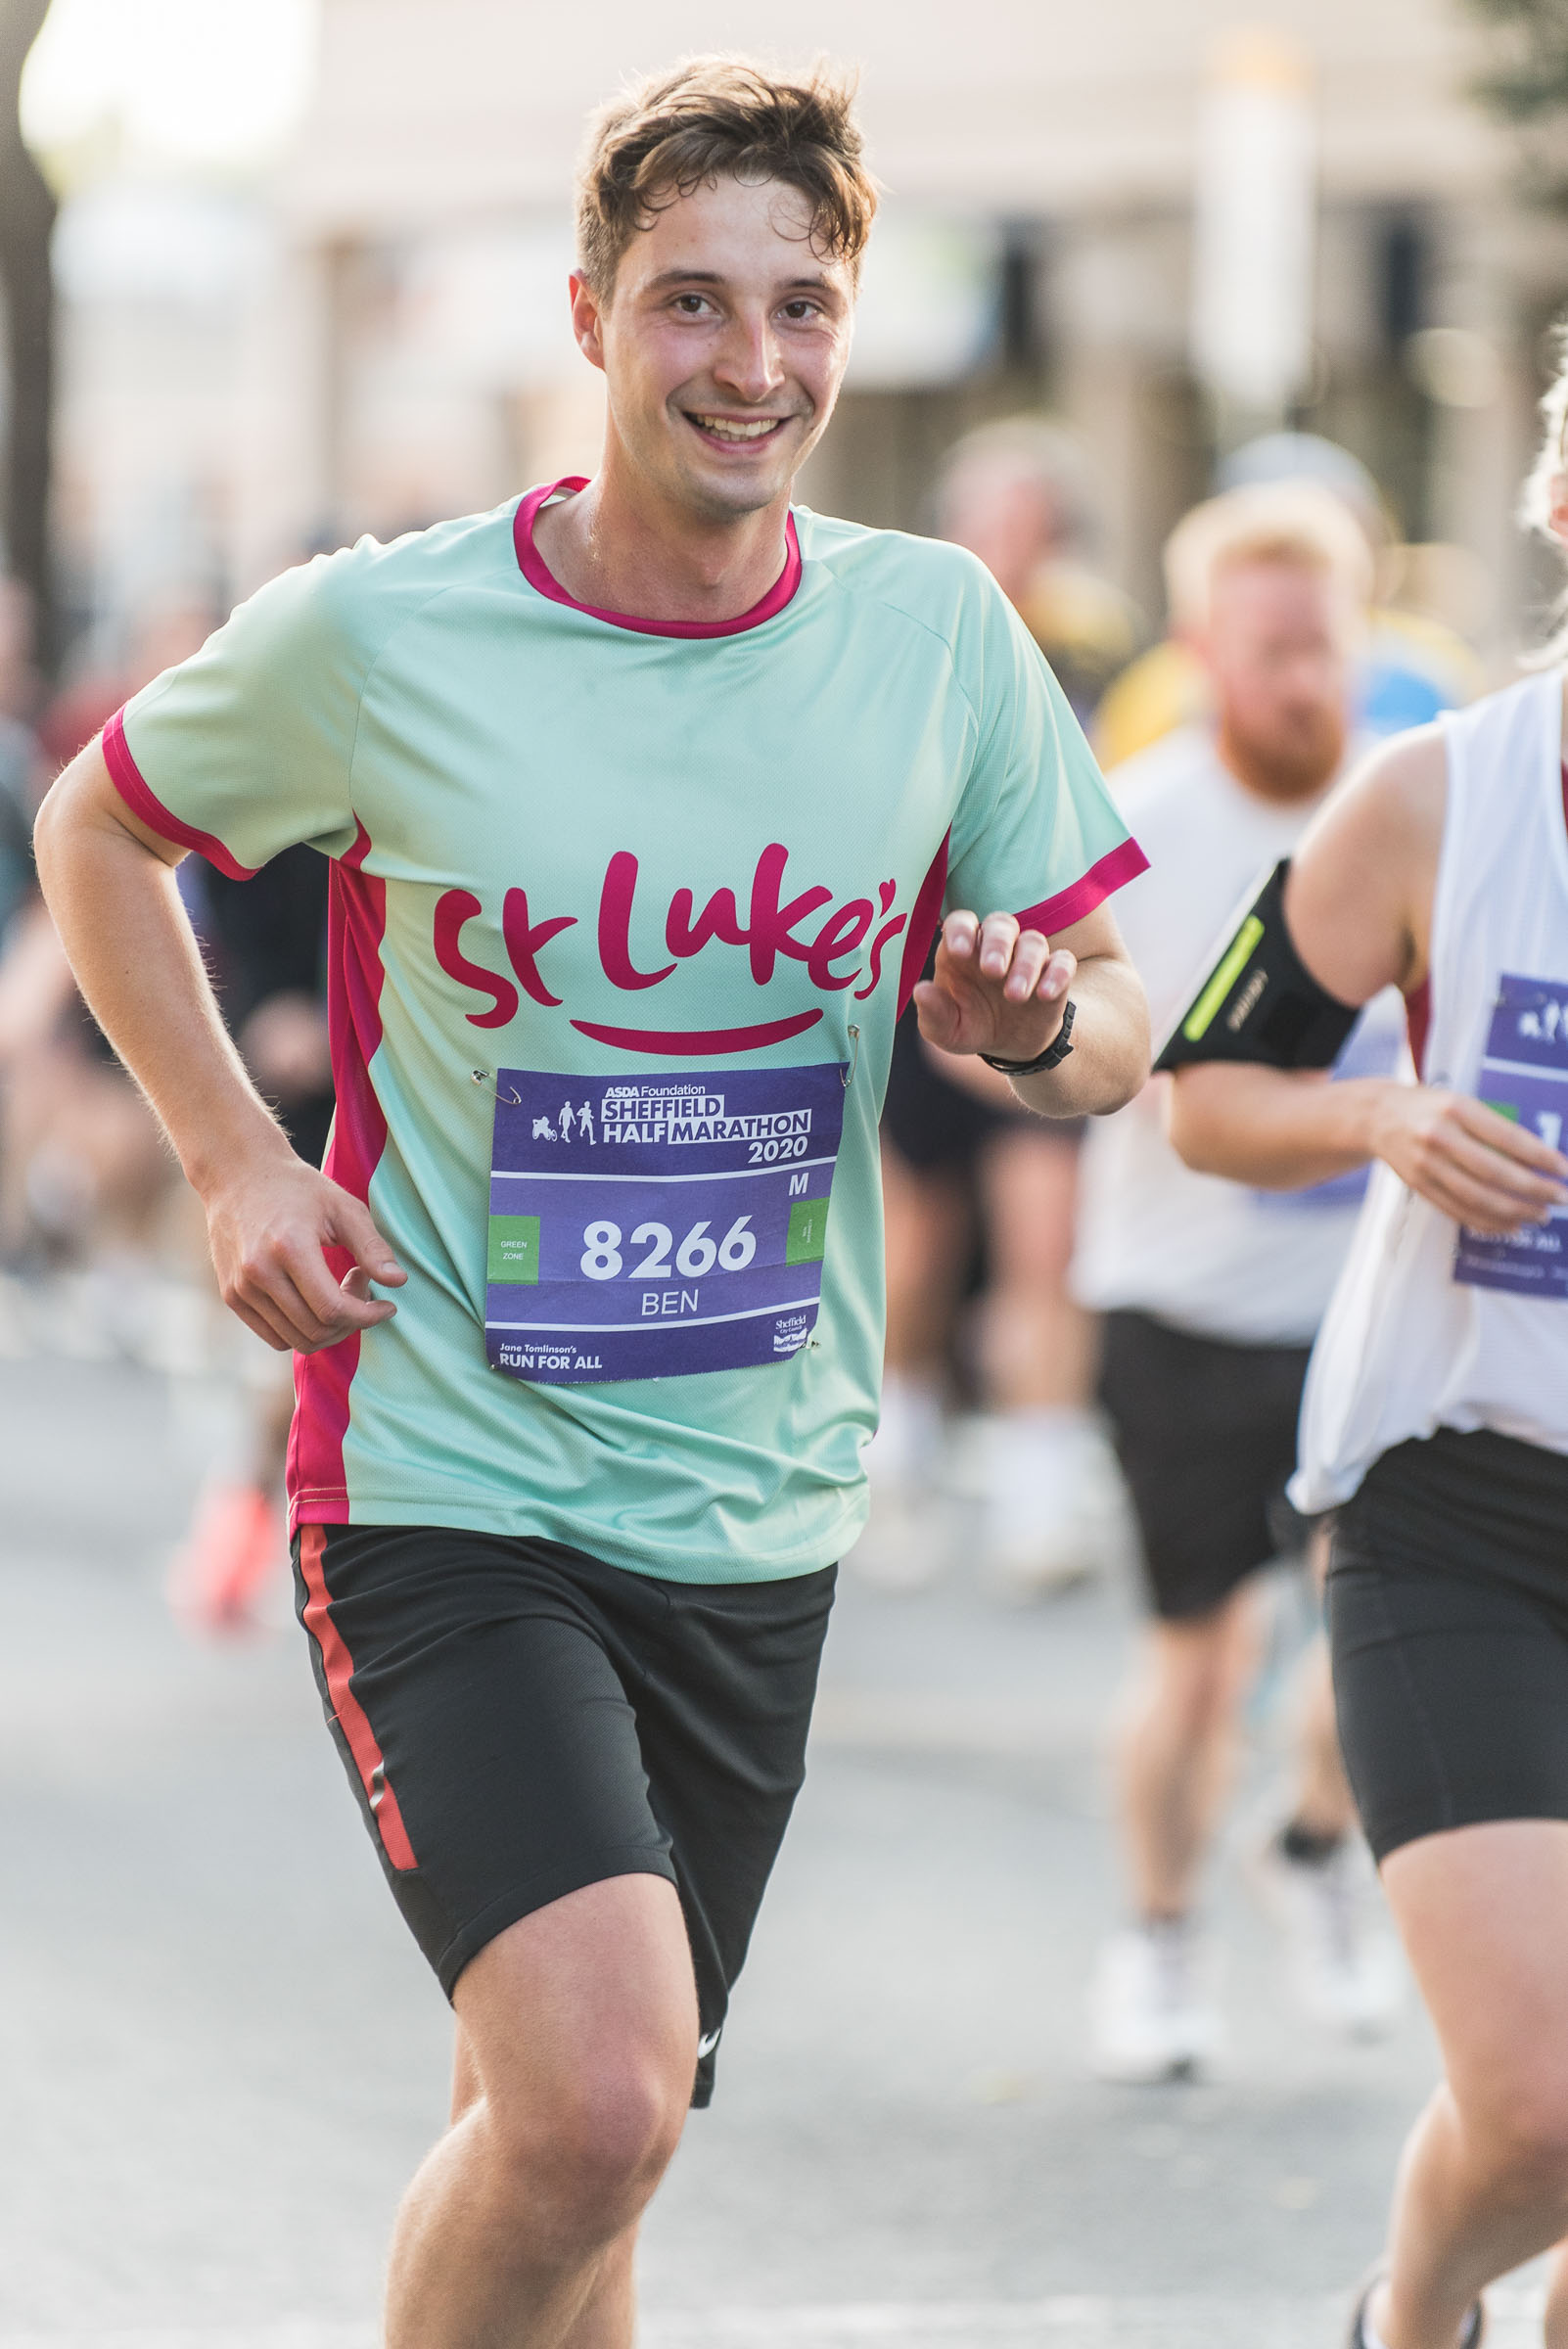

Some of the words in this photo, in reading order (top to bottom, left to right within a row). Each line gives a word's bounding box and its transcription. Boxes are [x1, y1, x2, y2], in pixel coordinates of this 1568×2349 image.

[597, 843, 907, 1000] Luke's
[605, 1086, 639, 1098] ASDA
[641, 1084, 705, 1097] Foundation
[604, 1097, 721, 1120] SHEFFIELD
[603, 1123, 667, 1143] HALF
[671, 1112, 809, 1142] MARATHON
[748, 1135, 808, 1164] 2020
[788, 1173, 809, 1196] M
[500, 1240, 528, 1249] GREEN
[580, 1215, 757, 1281] 8266
[502, 1252, 524, 1261] ZONE
[641, 1289, 699, 1316] BEN
[775, 1314, 807, 1330] Sheffield
[499, 1343, 522, 1353] Jane
[525, 1344, 576, 1354] Tomlinson's
[499, 1353, 534, 1368] RUN
[538, 1356, 570, 1369] FOR
[574, 1356, 603, 1369] ALL
